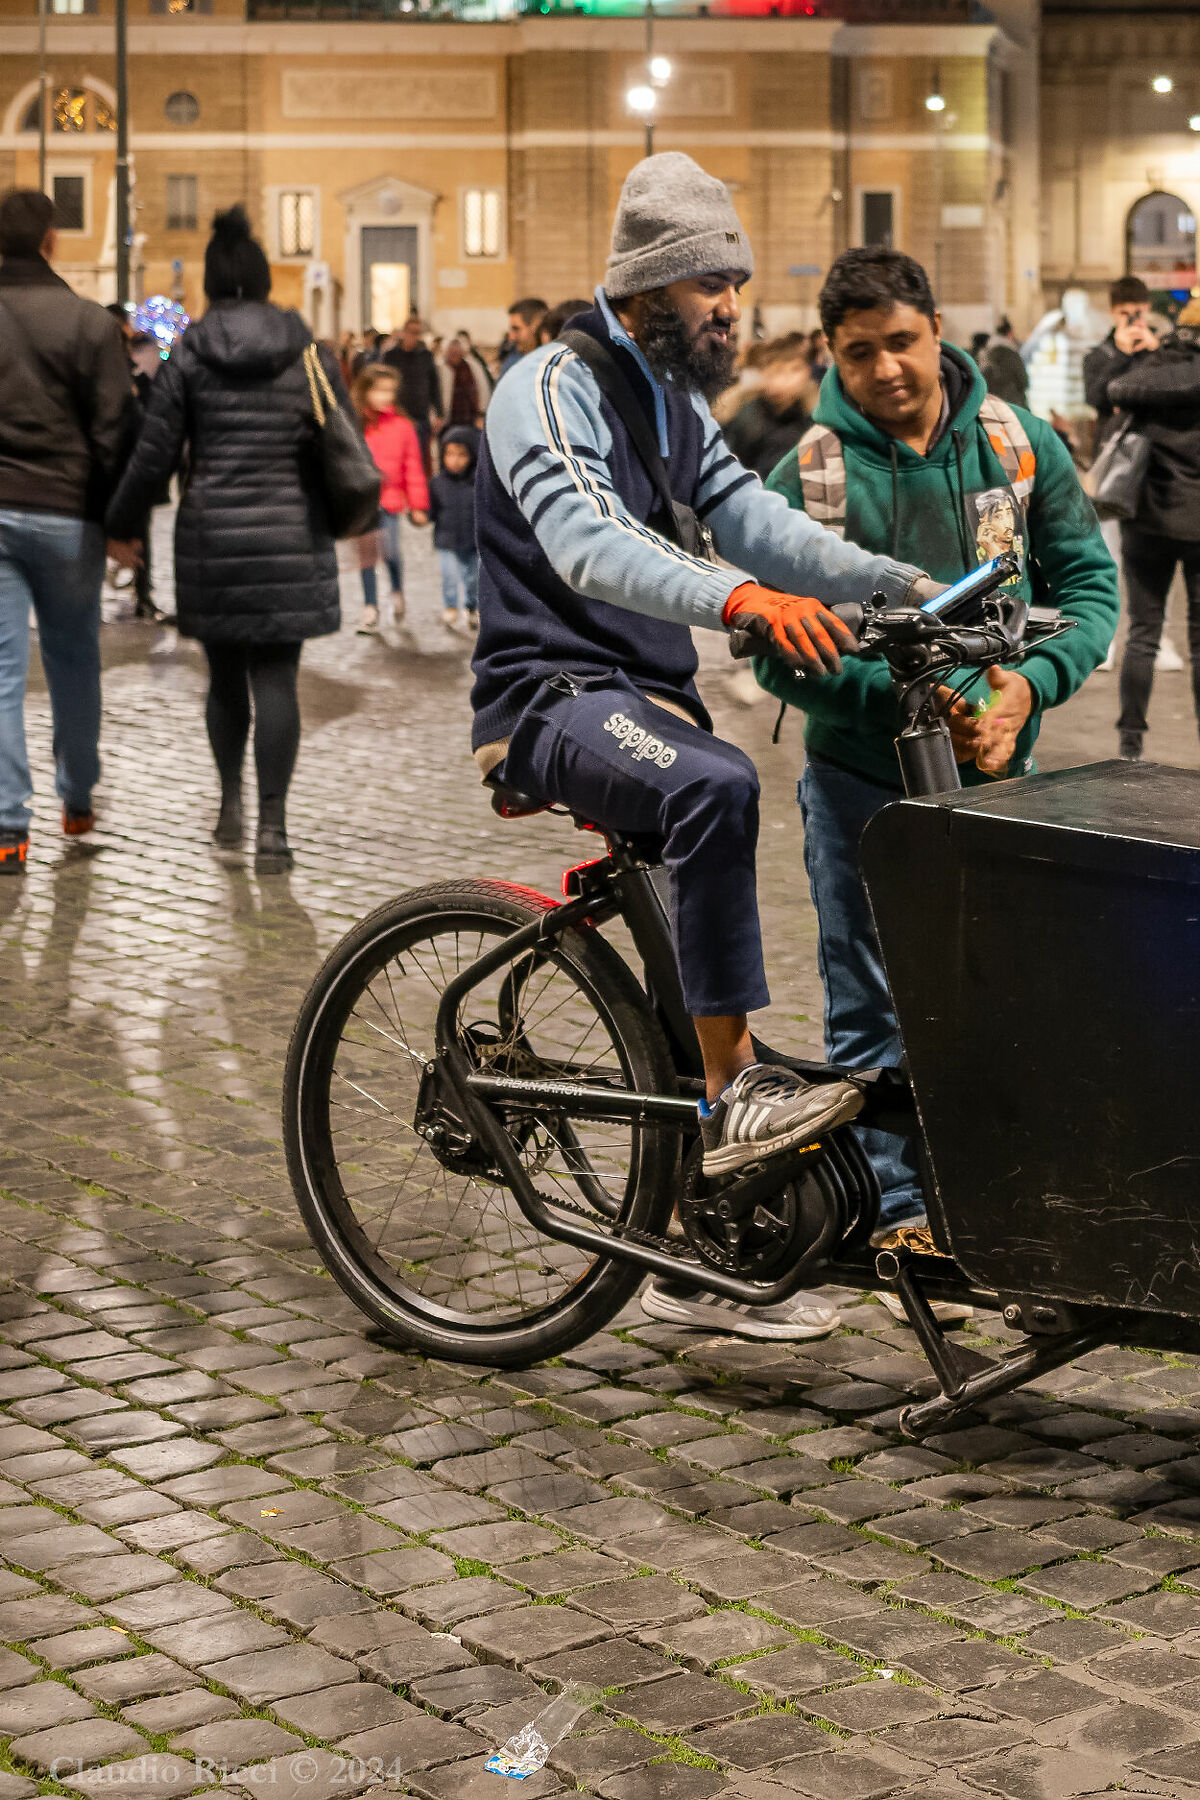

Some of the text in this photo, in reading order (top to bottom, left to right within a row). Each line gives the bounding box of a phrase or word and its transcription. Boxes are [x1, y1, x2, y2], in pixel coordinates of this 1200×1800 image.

[603, 713, 678, 769] adidas
[495, 1077, 587, 1096] URBAN ARROW
